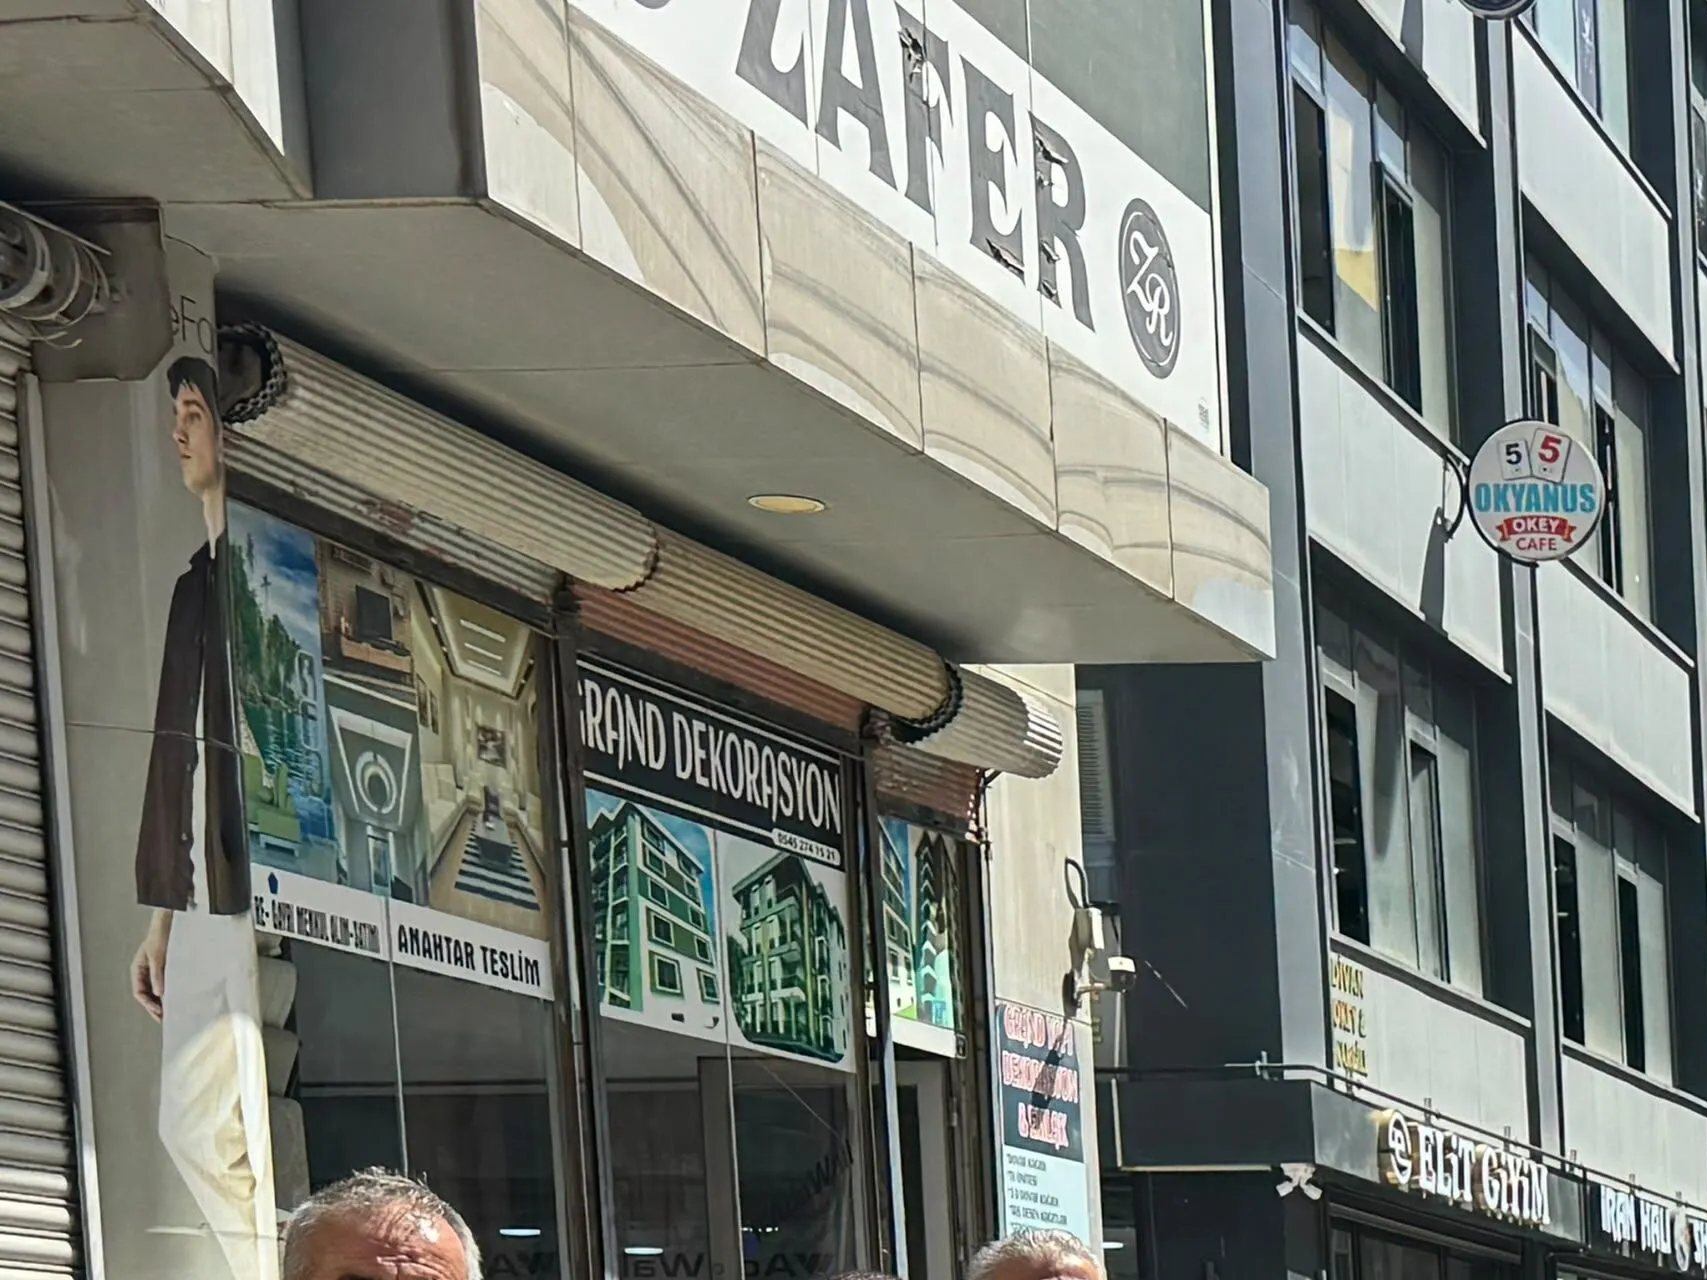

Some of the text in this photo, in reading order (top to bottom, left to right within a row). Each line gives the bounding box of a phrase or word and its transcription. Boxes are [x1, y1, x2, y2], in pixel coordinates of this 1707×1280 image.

[1505, 442, 1522, 465] 5
[1538, 434, 1562, 464] 5
[1474, 483, 1596, 513] OKYANUS
[1512, 517, 1560, 533] OKEY
[1516, 537, 1557, 551] CAFE
[671, 710, 842, 835] DEKORASYON
[397, 924, 542, 988] ANAHTAR TESLİM
